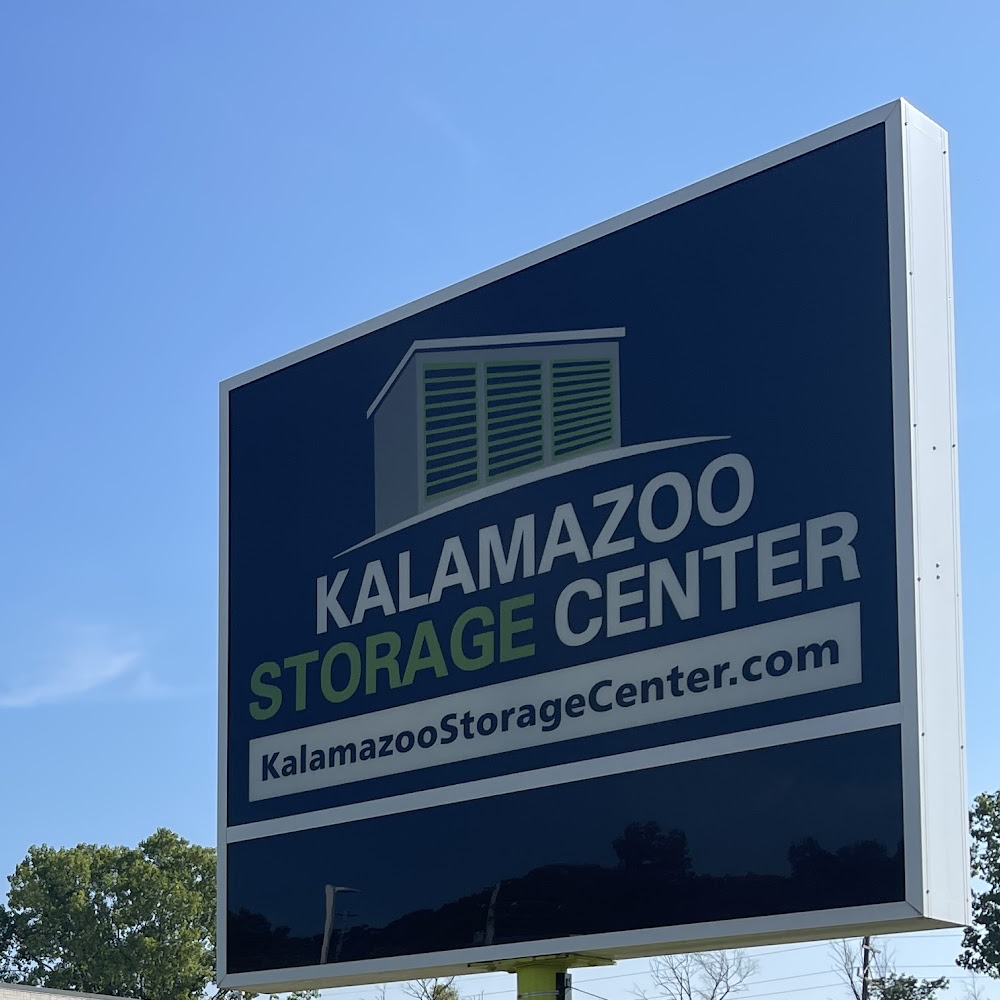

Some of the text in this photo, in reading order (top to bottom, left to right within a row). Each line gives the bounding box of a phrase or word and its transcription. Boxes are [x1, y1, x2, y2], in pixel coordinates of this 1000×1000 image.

[249, 511, 861, 722] STORAGE CENTER
[315, 452, 755, 635] KALAMAZOO
[261, 639, 840, 782] KalamazooStorageCenter.com
